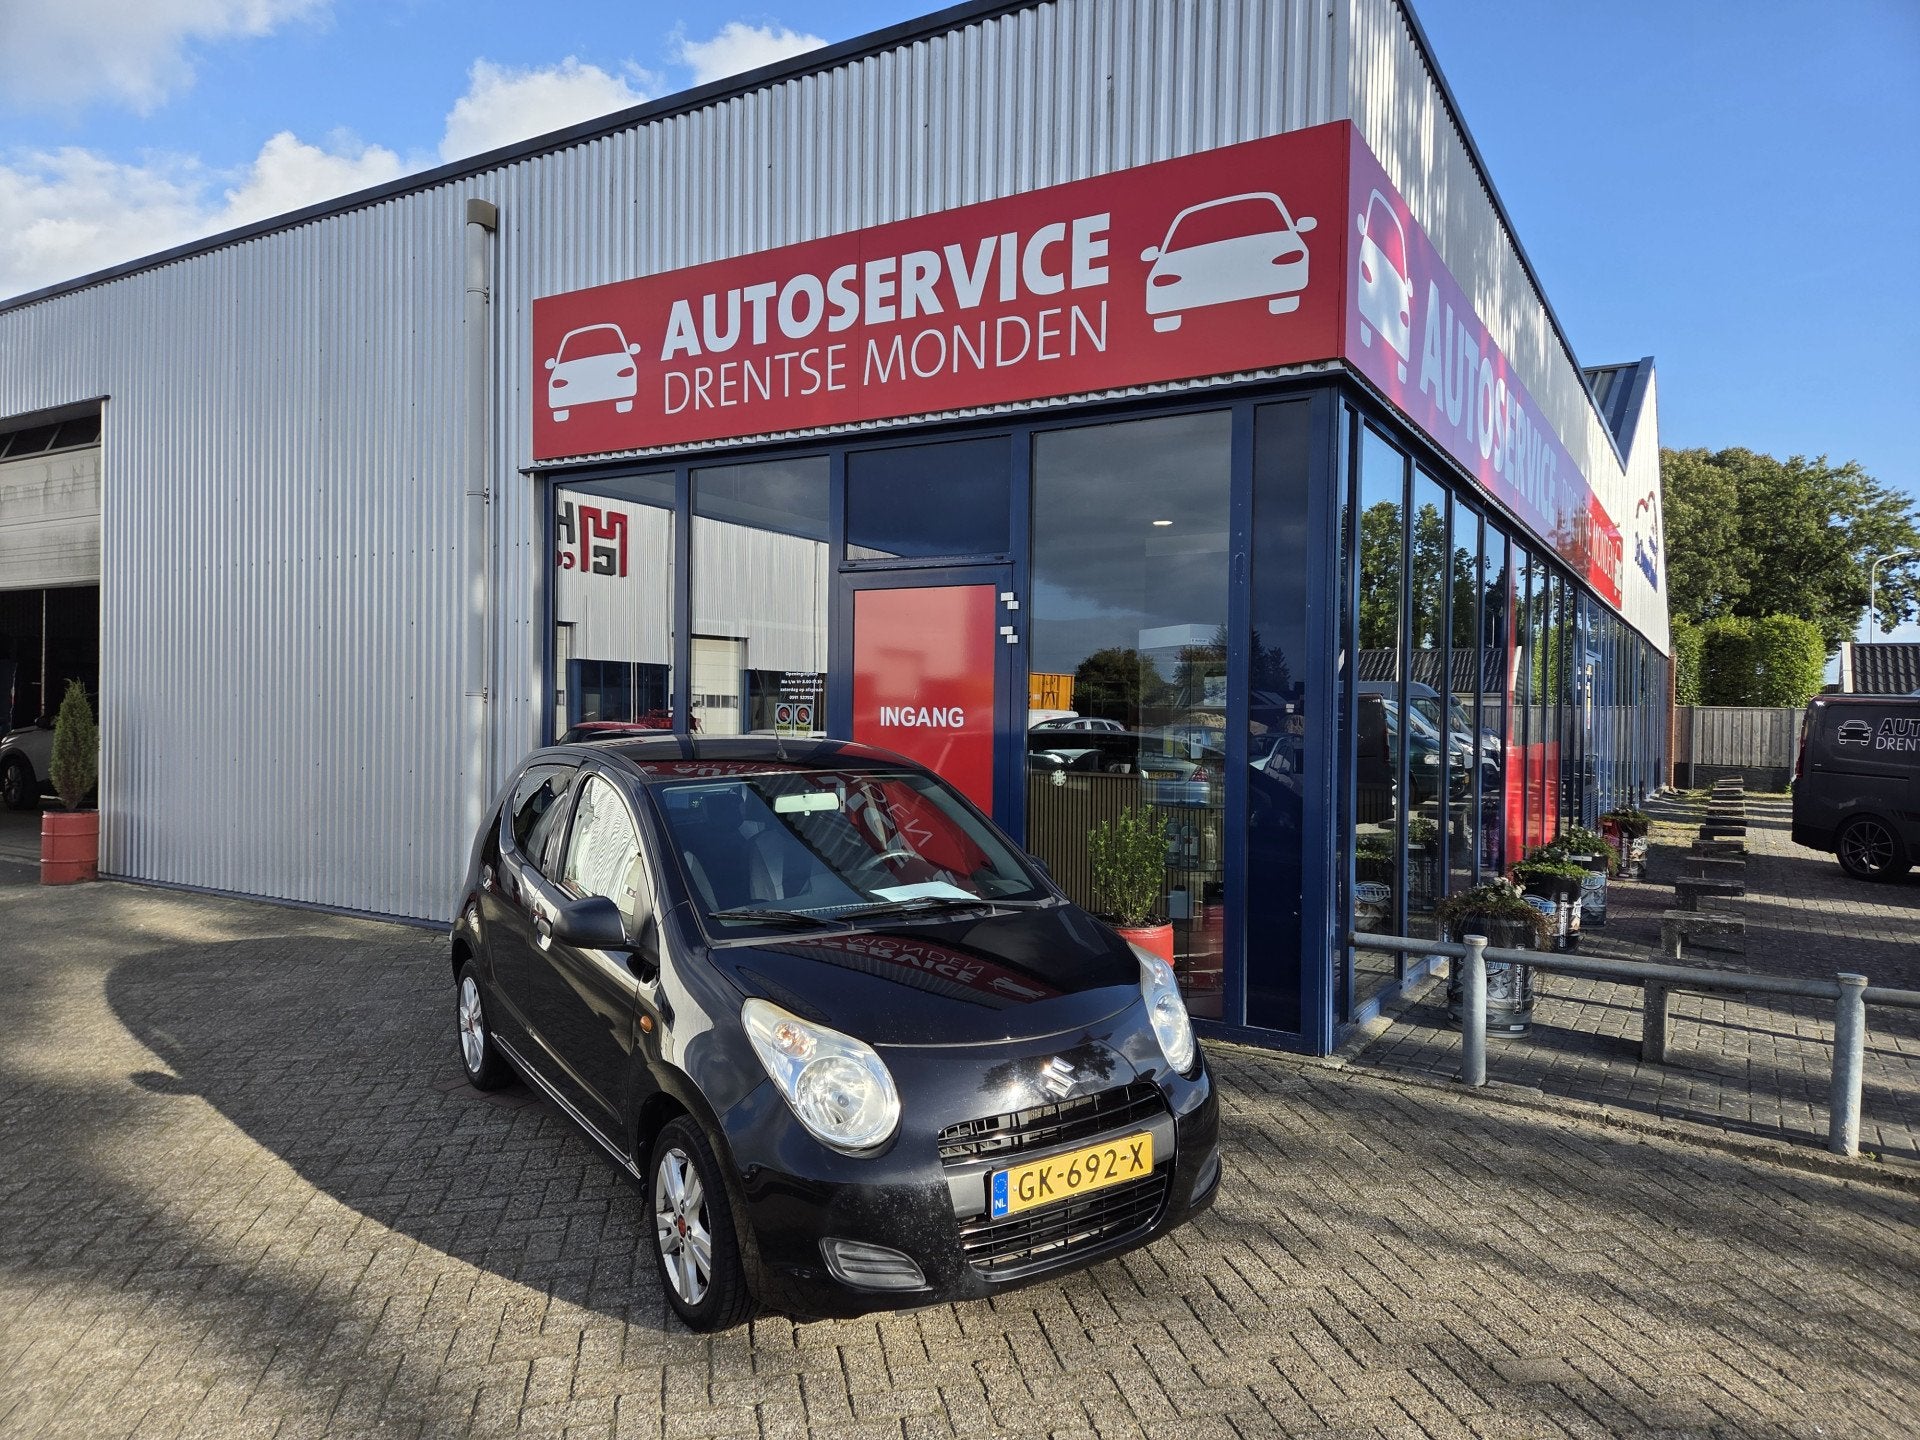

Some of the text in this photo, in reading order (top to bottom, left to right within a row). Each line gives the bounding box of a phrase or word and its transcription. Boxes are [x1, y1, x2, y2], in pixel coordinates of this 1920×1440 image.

[660, 213, 1111, 360] AUTOSERVICE
[663, 300, 1107, 415] DRENTSE MONDEN
[1420, 279, 1557, 526] AUTOSERVICE
[880, 706, 964, 728] INGANG
[995, 1198, 1007, 1210] NL
[1018, 1141, 1144, 1202] GK-692-X
